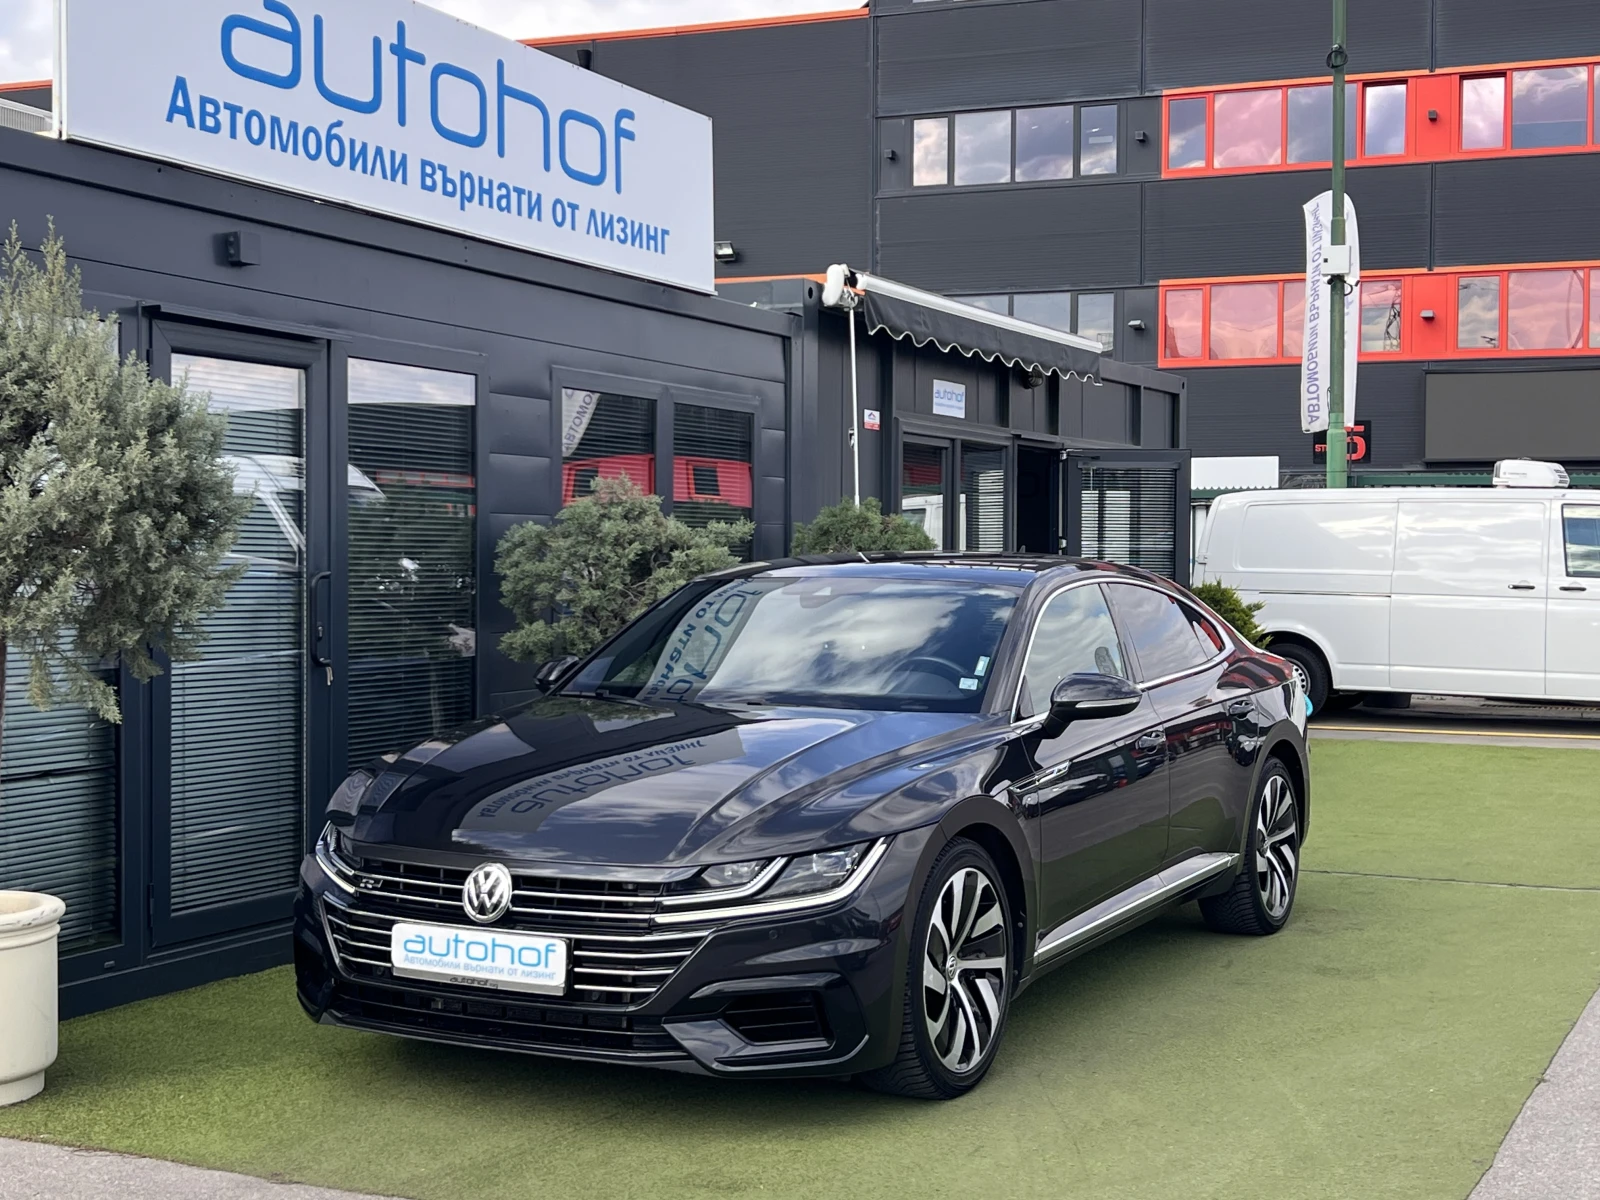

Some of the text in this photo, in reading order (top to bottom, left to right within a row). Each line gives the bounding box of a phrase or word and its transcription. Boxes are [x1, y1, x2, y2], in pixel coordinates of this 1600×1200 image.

[220, 0, 636, 194] autohof
[165, 75, 670, 255] Автомобили върнати от лизинг
[935, 389, 964, 403] autohof
[403, 953, 557, 980] Автомобили върнати от лизинг
[404, 933, 556, 968] autohof
